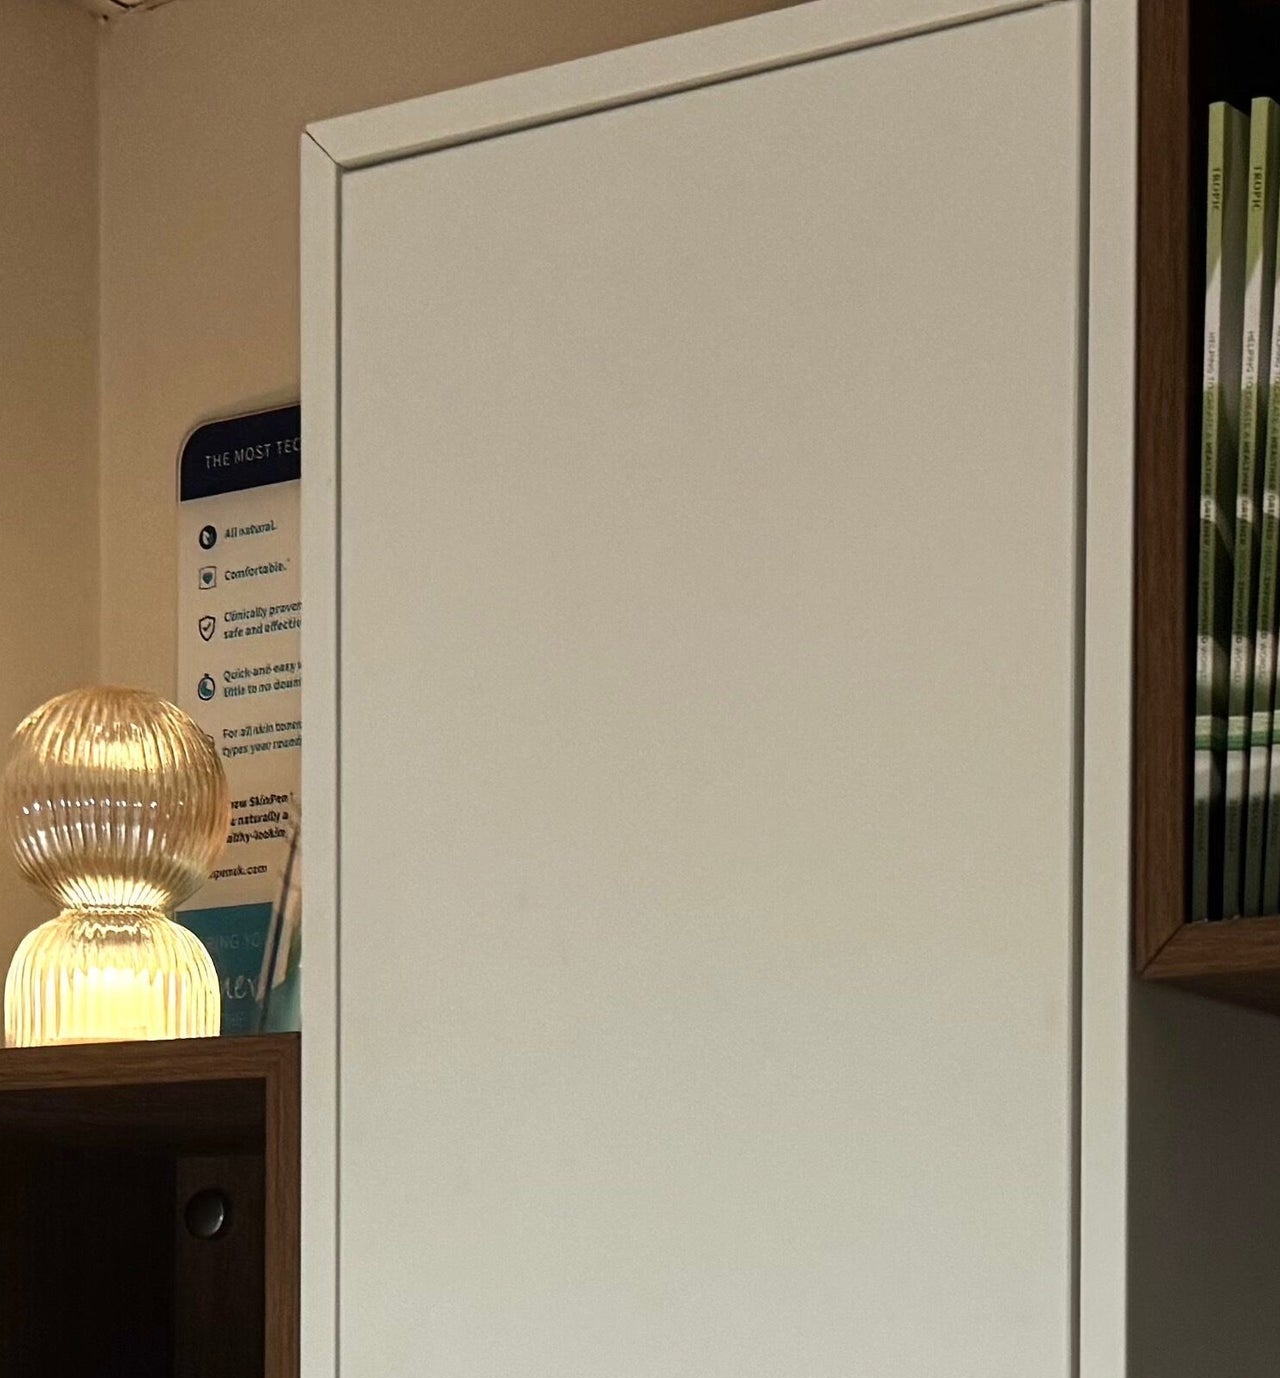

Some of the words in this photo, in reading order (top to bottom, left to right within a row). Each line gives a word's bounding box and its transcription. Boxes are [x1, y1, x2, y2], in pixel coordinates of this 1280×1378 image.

[1211, 167, 1221, 211] TROPIC
[1251, 165, 1262, 211] TROPIC
[1207, 331, 1217, 372] HELPING
[1246, 330, 1255, 373] HELPING
[205, 452, 230, 469] THE
[234, 443, 271, 464] MOST
[224, 526, 238, 539] All
[224, 604, 267, 622] Clinically
[224, 626, 244, 640] safe
[244, 623, 263, 637] and
[222, 727, 239, 740] For
